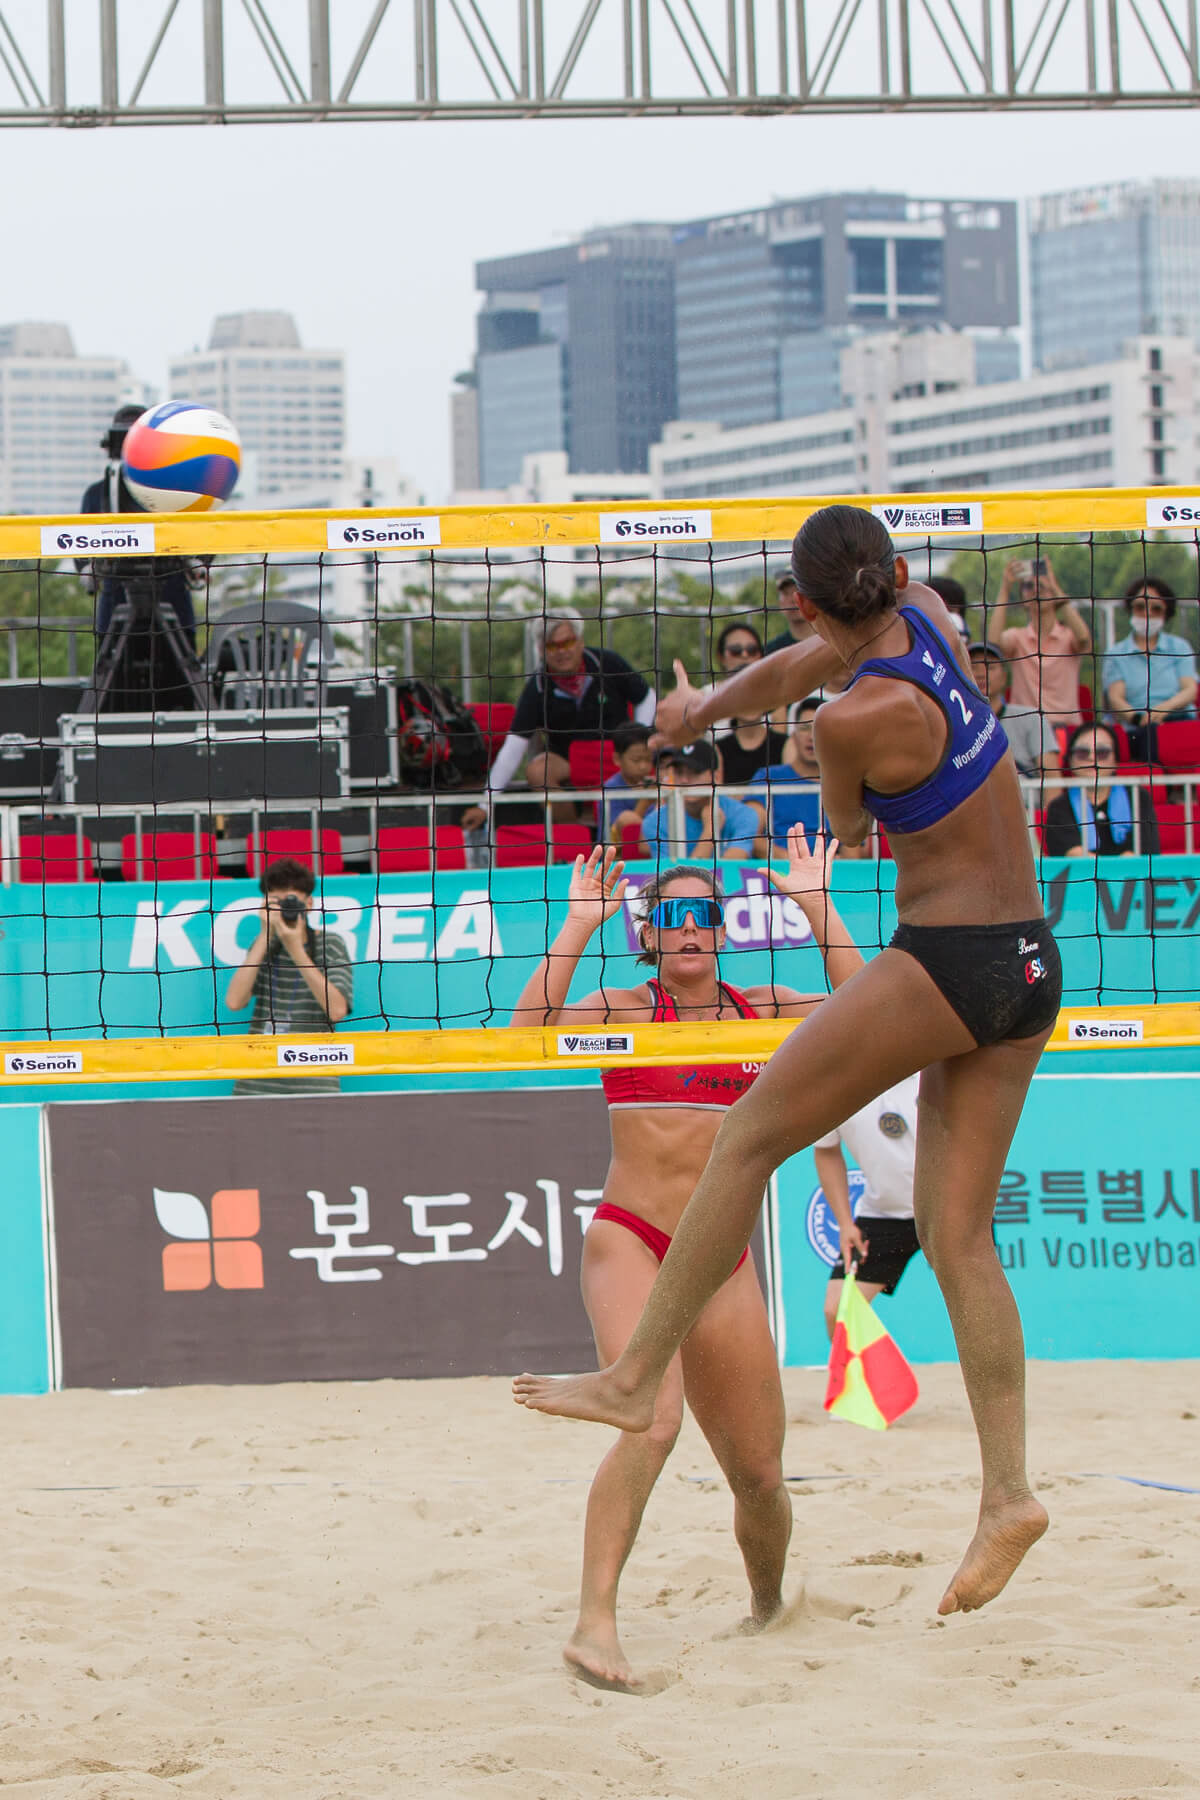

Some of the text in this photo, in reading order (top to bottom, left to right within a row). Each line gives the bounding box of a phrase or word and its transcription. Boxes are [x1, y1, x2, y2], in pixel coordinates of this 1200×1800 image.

[904, 511, 940, 521] BEACH
[634, 521, 697, 535] Senoh
[362, 527, 425, 542] Senoh
[75, 534, 139, 549] Senoh
[949, 689, 973, 726] 2
[1089, 1027, 1138, 1038] Senoh
[579, 1039, 606, 1047] BEACH
[298, 1051, 349, 1063] Senoh
[25, 1059, 77, 1071] Senoh
